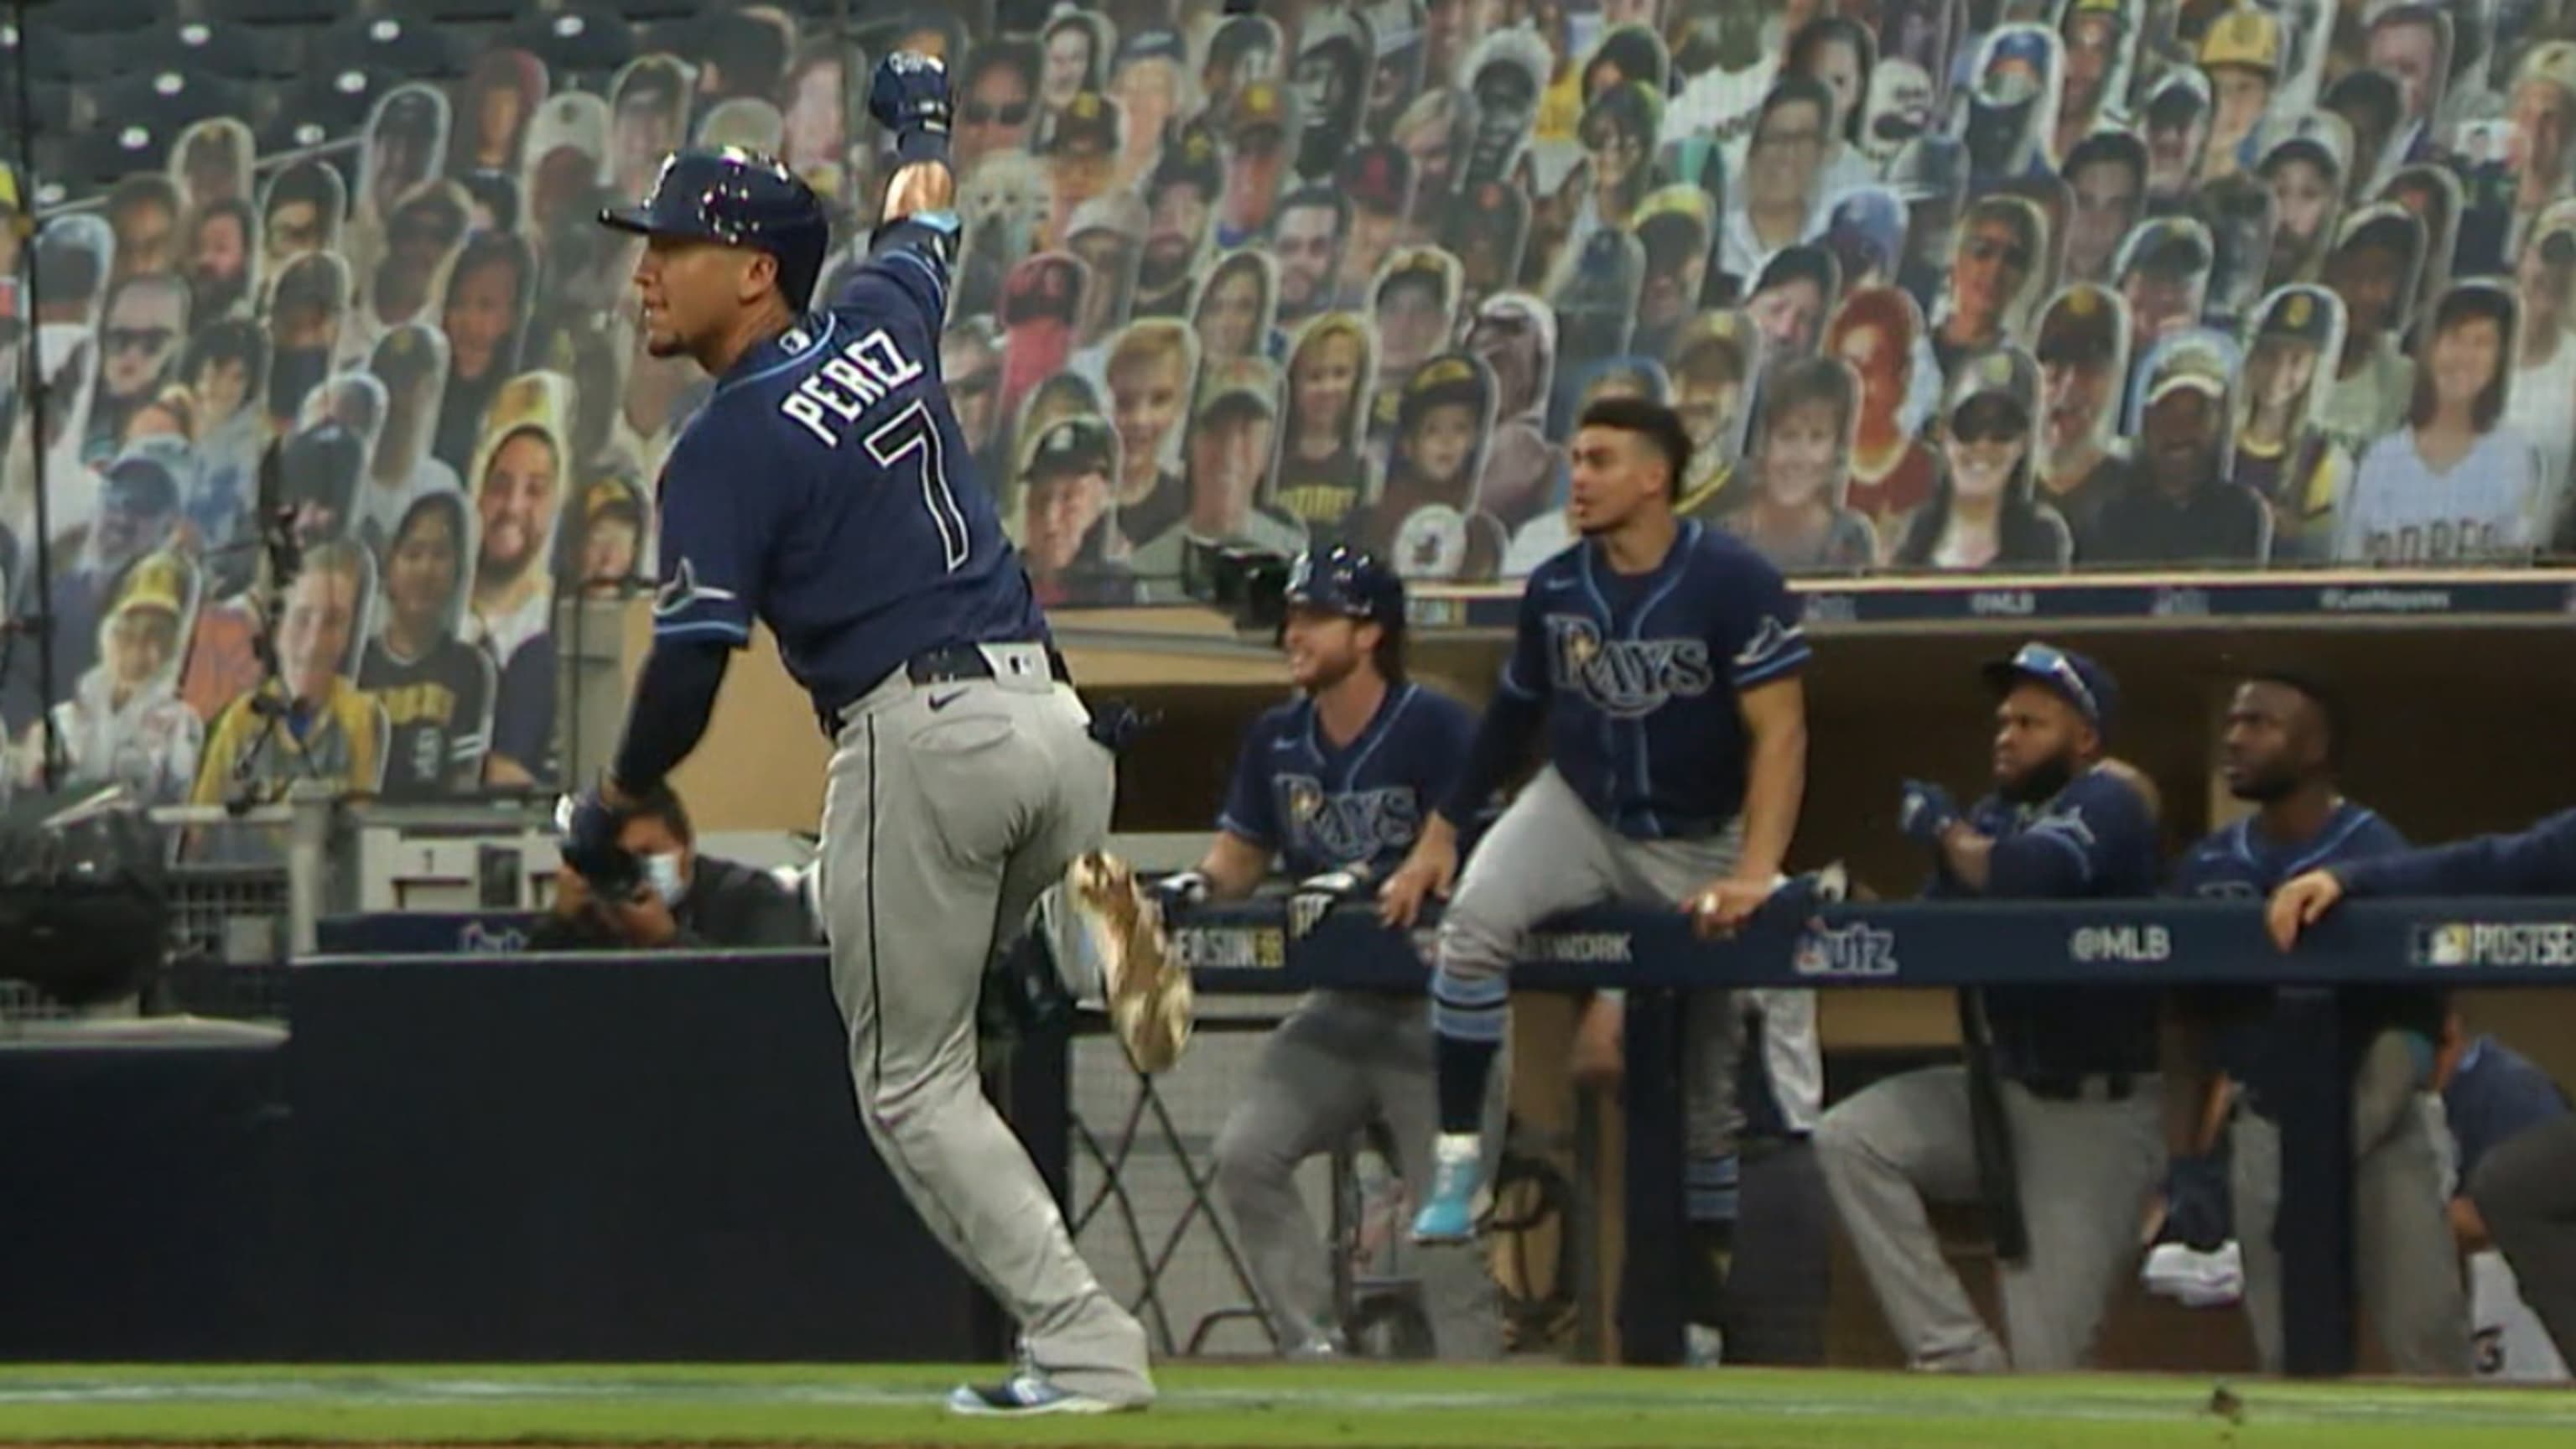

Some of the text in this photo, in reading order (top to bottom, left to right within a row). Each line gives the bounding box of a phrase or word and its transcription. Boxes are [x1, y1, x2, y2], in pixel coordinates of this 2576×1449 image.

[781, 328, 923, 448] PEREZ
[863, 398, 969, 574] 7
[2071, 926, 2170, 962] @MLB
